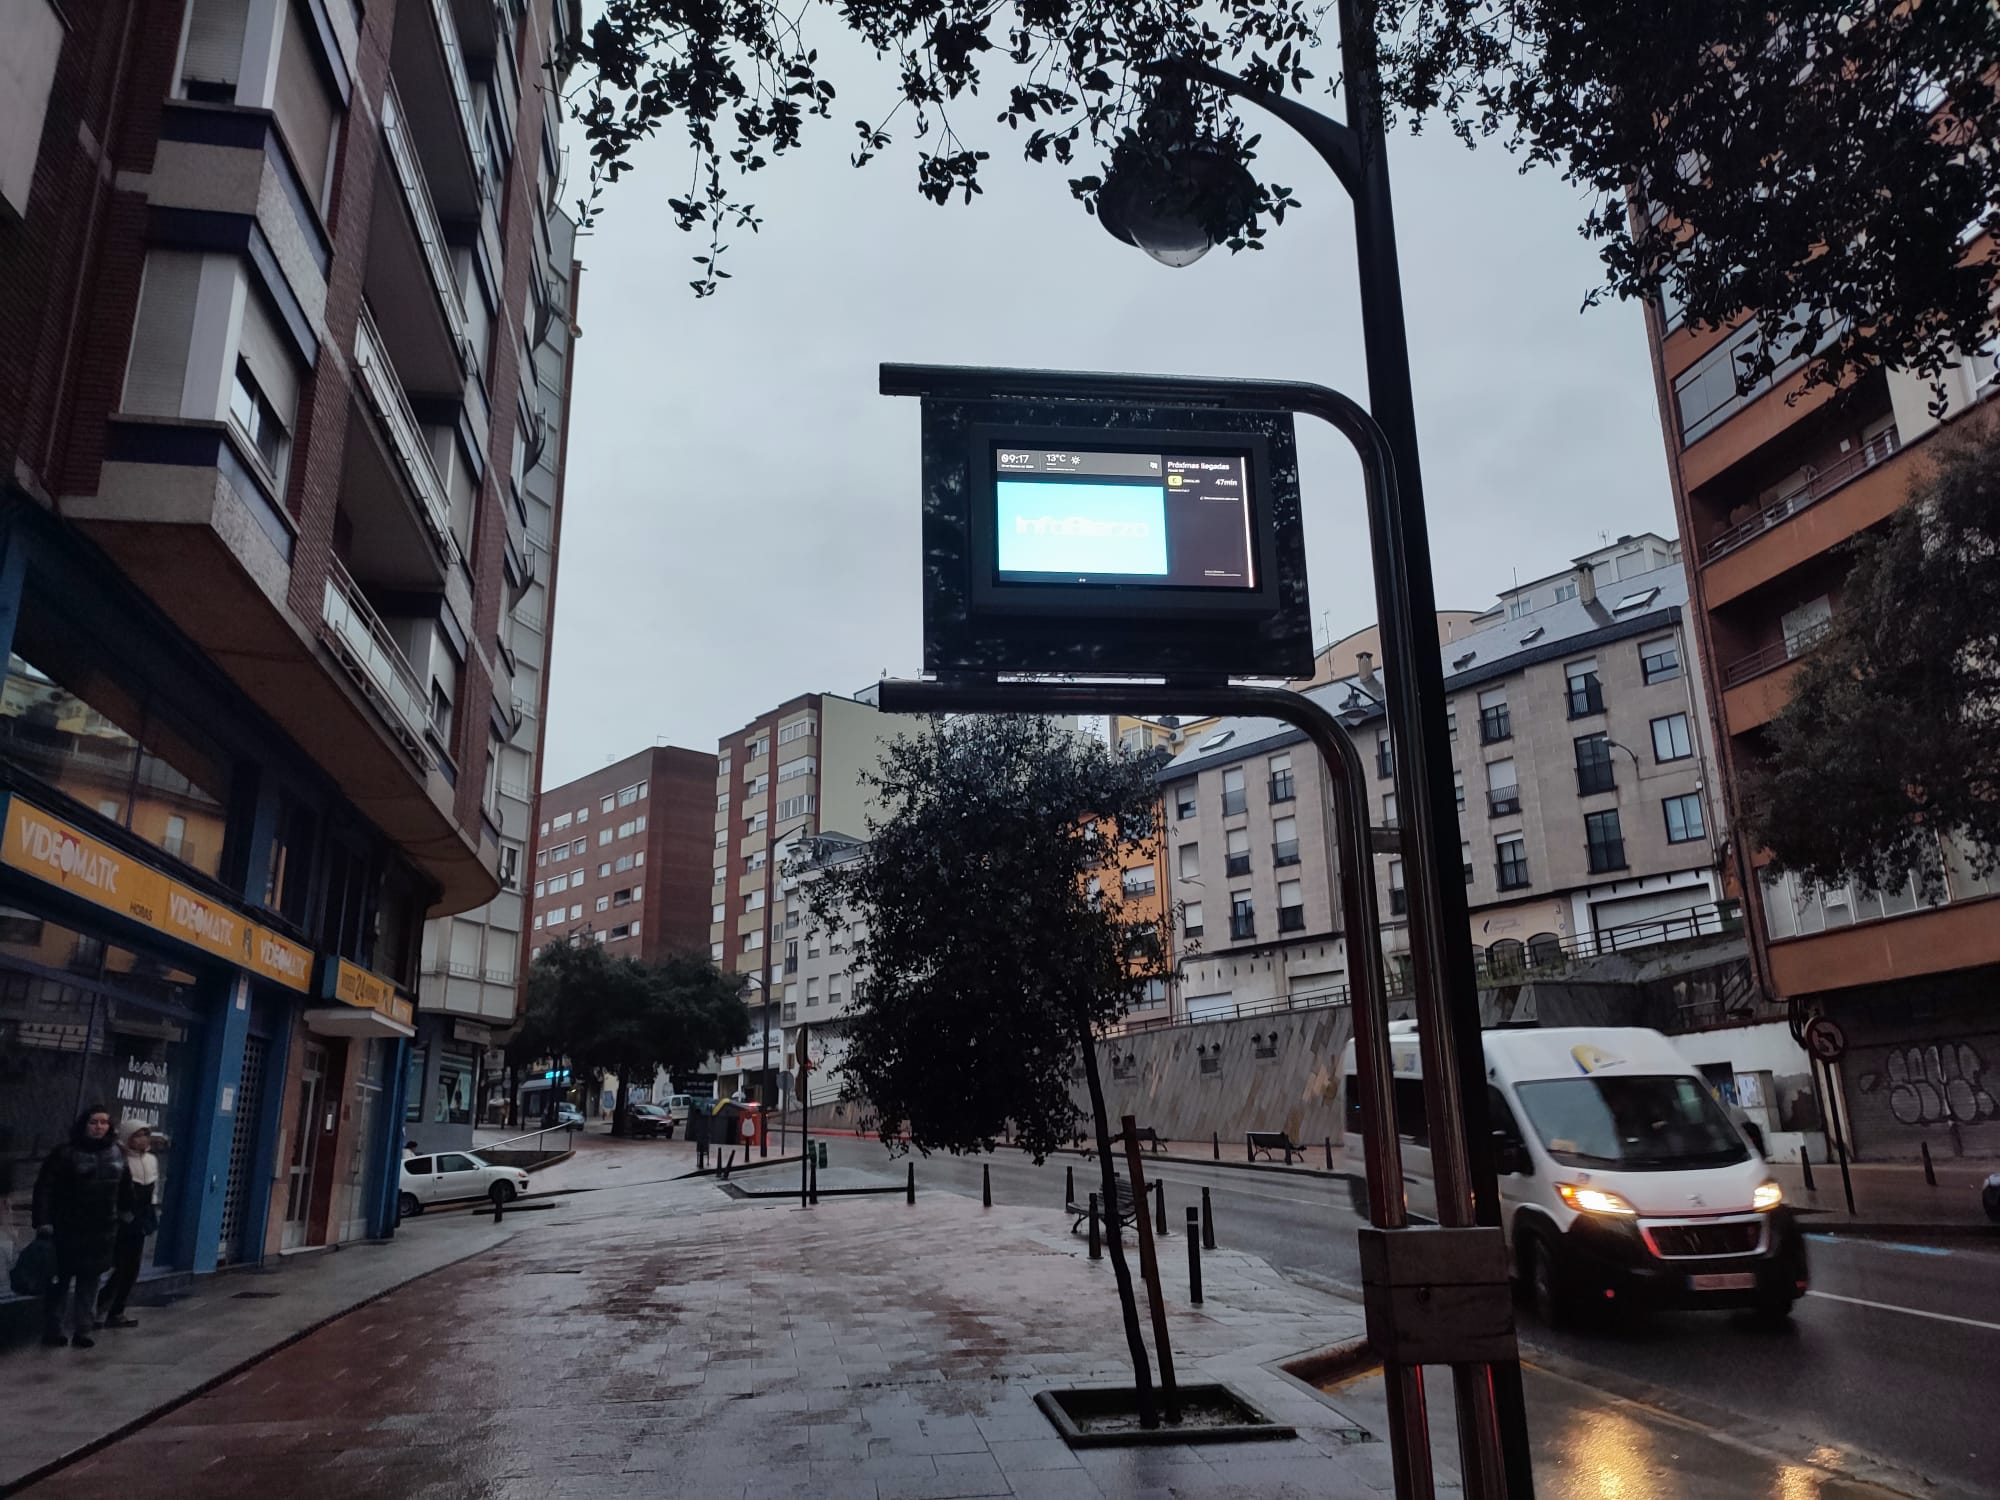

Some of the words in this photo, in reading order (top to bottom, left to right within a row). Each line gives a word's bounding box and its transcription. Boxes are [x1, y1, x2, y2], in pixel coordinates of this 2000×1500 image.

[1001, 454, 1030, 464] 09:17
[1045, 453, 1066, 463] 13°C
[1167, 461, 1200, 470] Próximas
[1200, 462, 1230, 471] llegadas
[1215, 478, 1238, 486] 47min
[21, 815, 121, 894] VIDEOMATIC
[129, 900, 153, 922] HORAS
[169, 891, 234, 947] VIDEOMATIC
[260, 938, 307, 981] VIDEOMATIC
[117, 1077, 136, 1100] PAN
[135, 1079, 142, 1101] Y
[140, 1080, 170, 1105] PRENSA
[121, 1105, 132, 1124] DE
